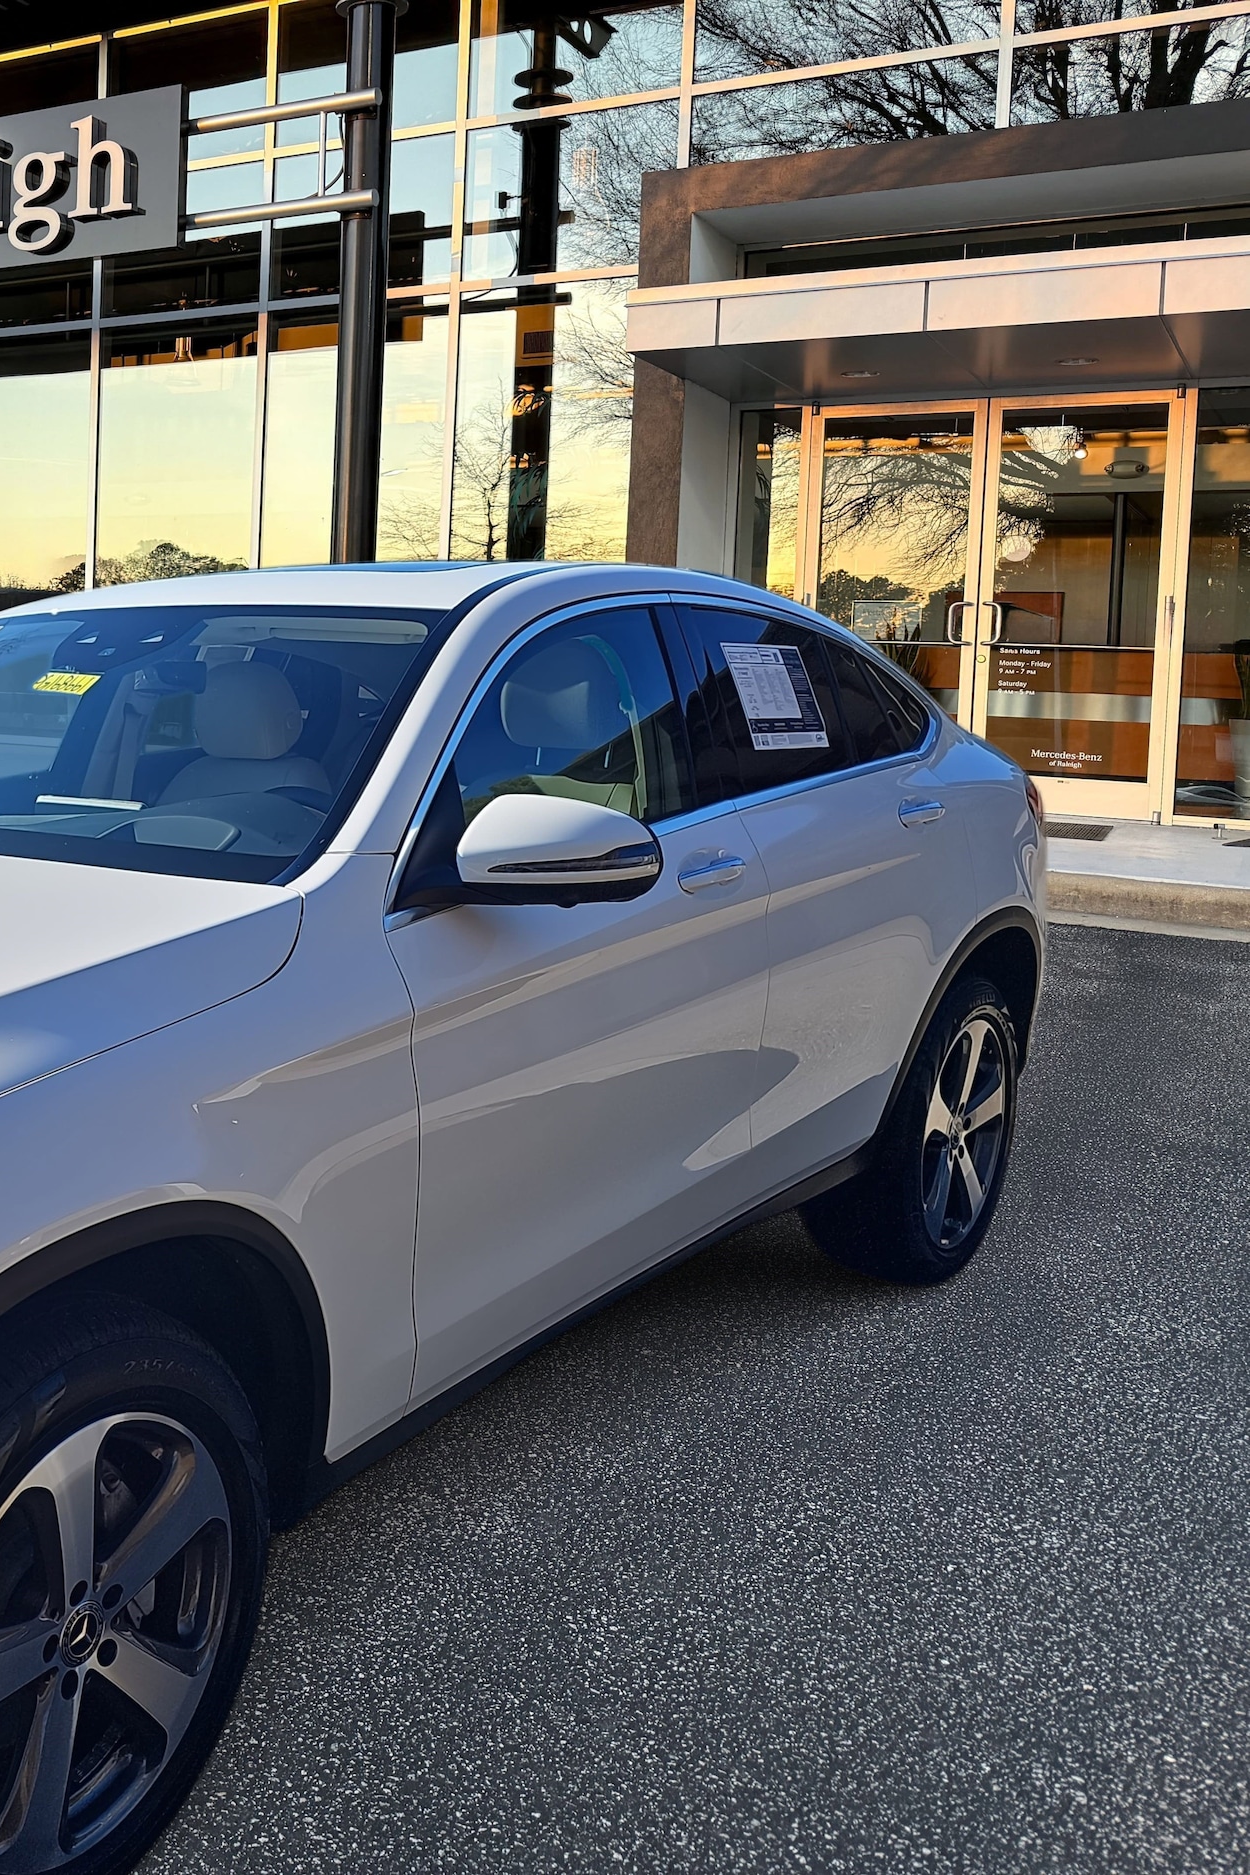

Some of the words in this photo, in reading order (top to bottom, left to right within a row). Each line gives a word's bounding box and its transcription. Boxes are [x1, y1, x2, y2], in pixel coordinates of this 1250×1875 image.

[998, 660, 1026, 668] Monday
[1030, 660, 1052, 669] Friday
[997, 680, 1027, 689] Saturday
[1030, 748, 1103, 762] Mercedes-Benz
[1057, 760, 1083, 769] Raleigh
